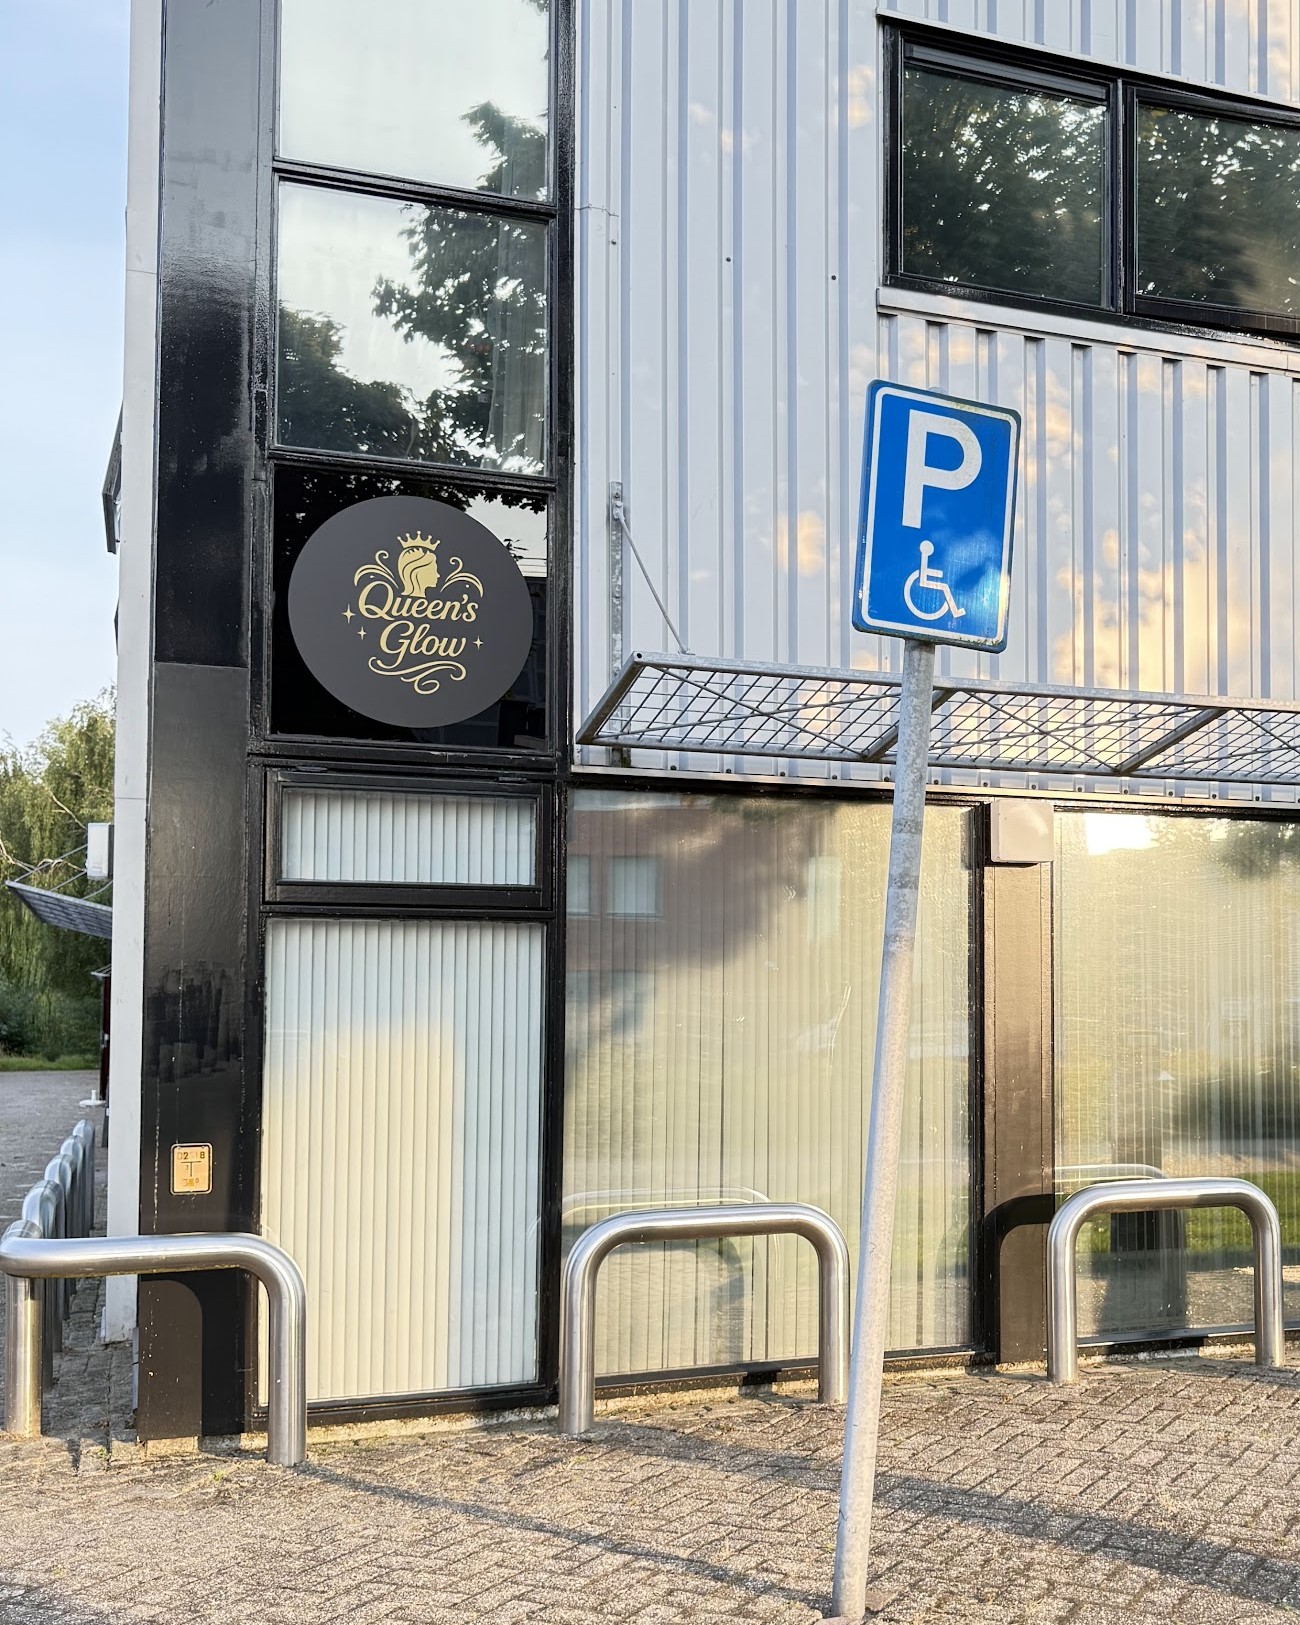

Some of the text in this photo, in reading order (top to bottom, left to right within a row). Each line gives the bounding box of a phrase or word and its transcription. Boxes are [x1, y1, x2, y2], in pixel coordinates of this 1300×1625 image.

[902, 409, 982, 528] P
[358, 581, 479, 622] Queen's
[377, 621, 466, 668] Glow
